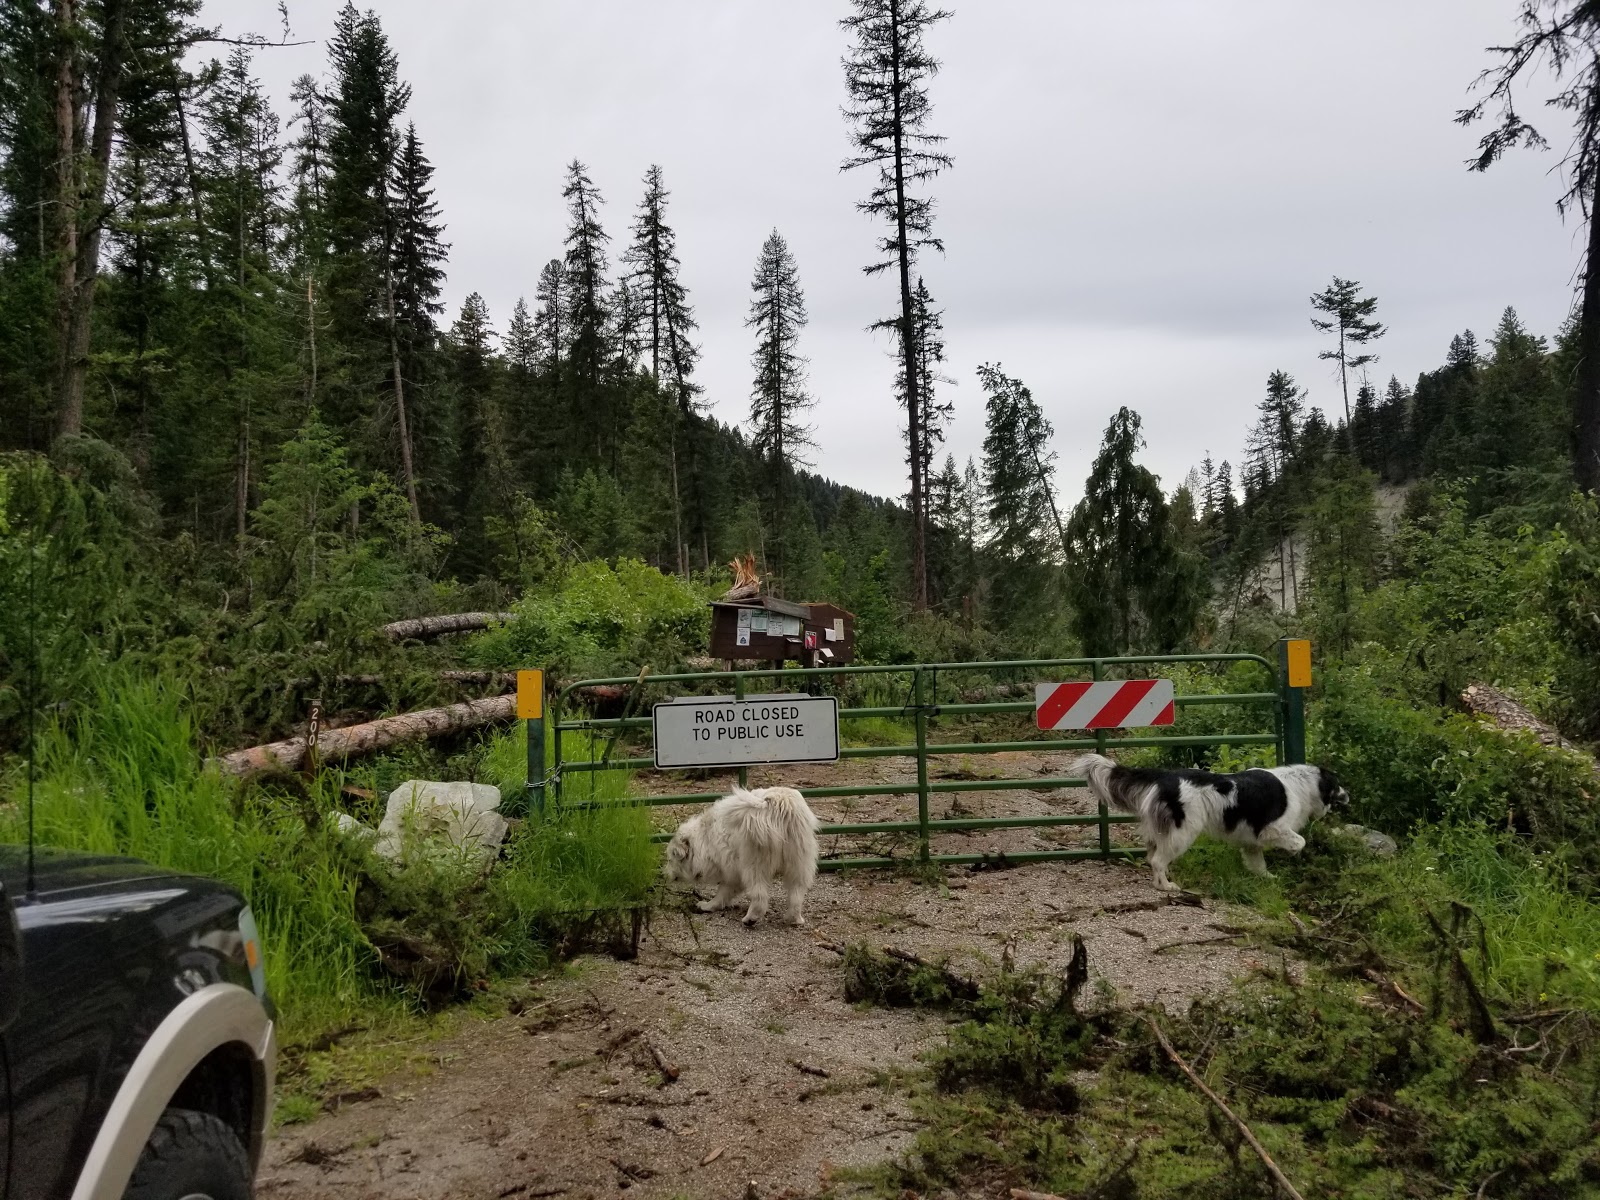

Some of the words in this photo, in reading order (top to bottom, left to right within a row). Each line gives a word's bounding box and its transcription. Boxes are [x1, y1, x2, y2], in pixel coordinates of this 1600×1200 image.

[695, 709, 735, 723] ROAD
[742, 707, 799, 721] CLOSED
[309, 708, 319, 746] 200
[693, 728, 710, 740] TO
[718, 725, 769, 740] PUBLIC
[775, 724, 804, 737] USE
